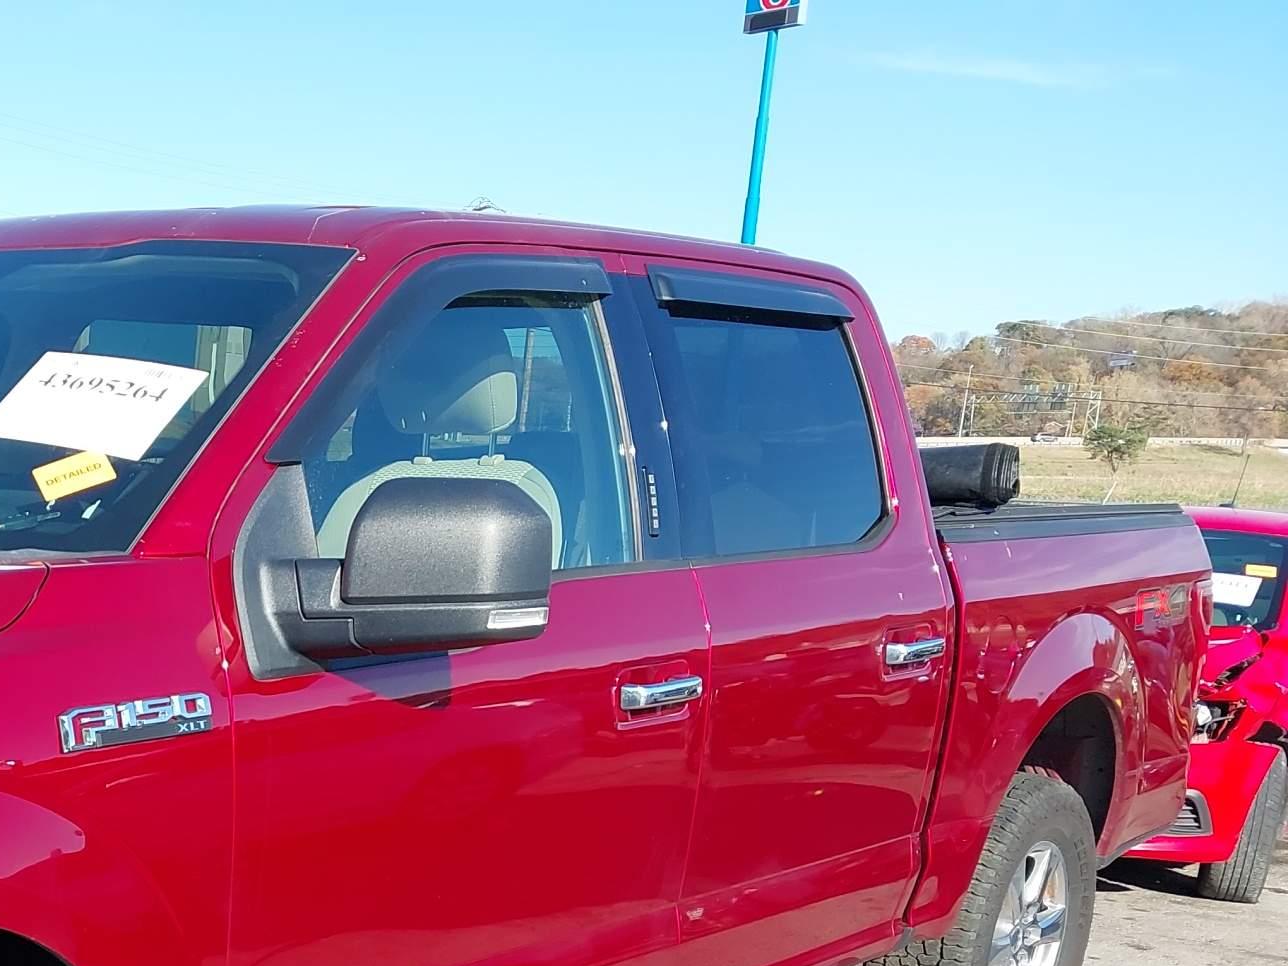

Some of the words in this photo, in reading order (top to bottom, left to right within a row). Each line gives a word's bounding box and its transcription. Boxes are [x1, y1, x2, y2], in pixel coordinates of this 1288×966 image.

[39, 372, 169, 402] 43695264
[45, 462, 102, 487] DETAILED
[1135, 585, 1187, 629] FX4
[59, 693, 212, 753] F150
[177, 720, 208, 733] XLT
